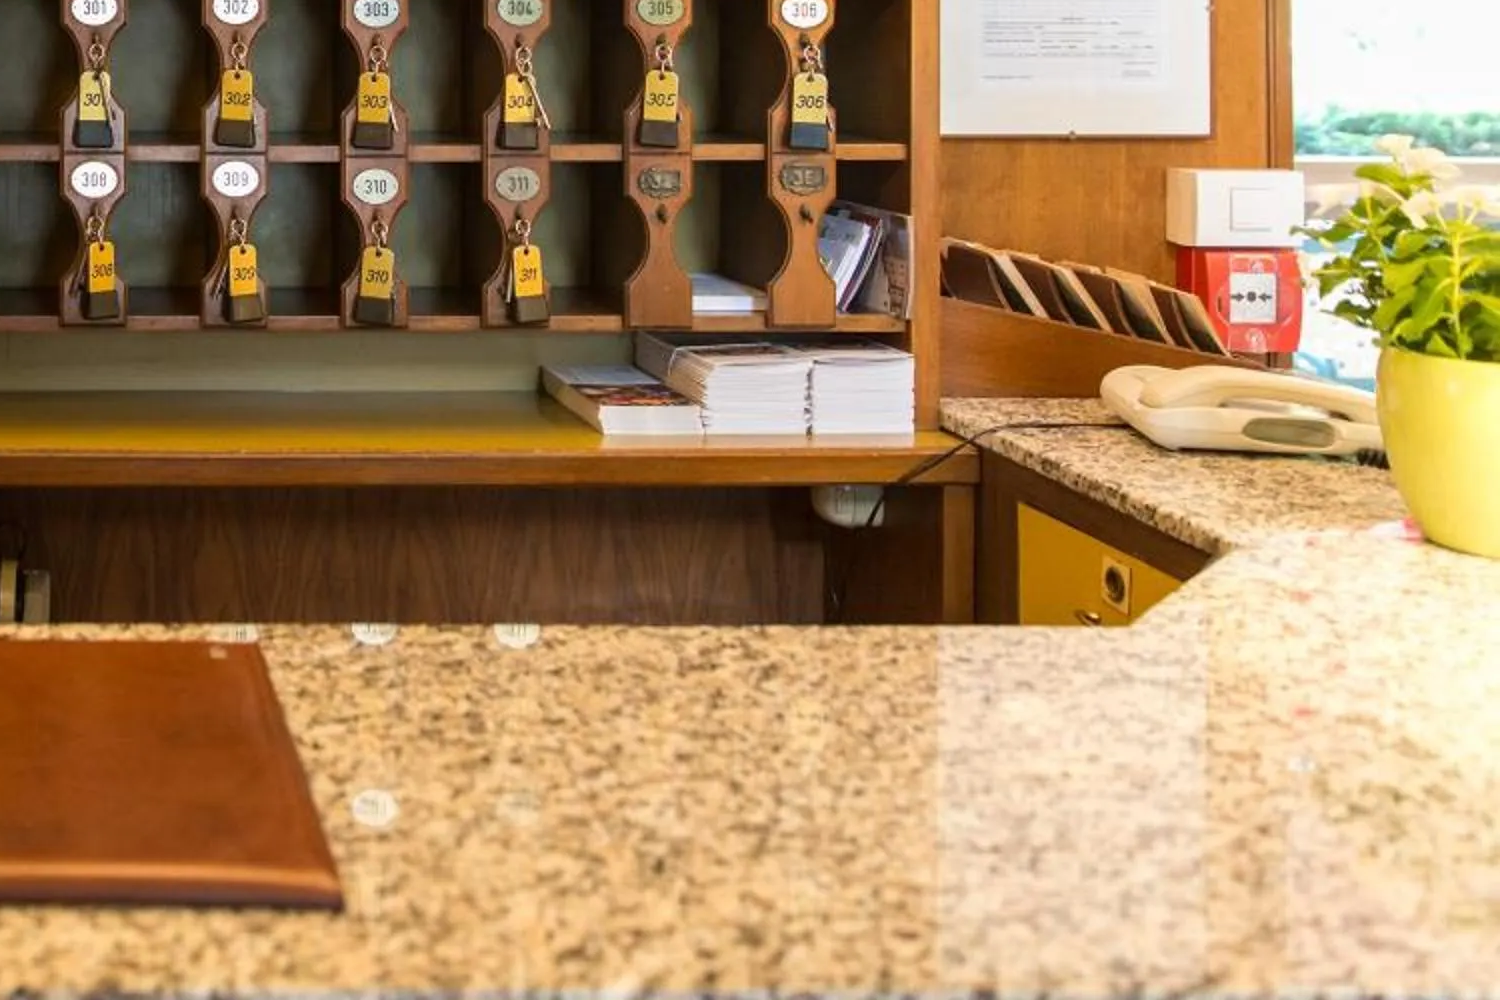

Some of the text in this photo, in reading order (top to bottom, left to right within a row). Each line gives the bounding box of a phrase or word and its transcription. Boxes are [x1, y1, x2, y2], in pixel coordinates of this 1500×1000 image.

[84, 0, 105, 15] 301
[224, 0, 248, 14] 302
[364, 2, 388, 17] 303
[508, 0, 532, 16] 304
[648, 0, 673, 16] 305
[792, 3, 816, 18] 306
[225, 92, 251, 105] 302
[362, 95, 387, 109] 303
[646, 93, 675, 106] 305
[796, 95, 824, 108] 306
[82, 172, 106, 187] 308
[224, 172, 248, 186] 309
[509, 176, 528, 193] 311
[366, 180, 386, 194] 310
[365, 270, 389, 283] 310
[520, 267, 538, 282] 311
